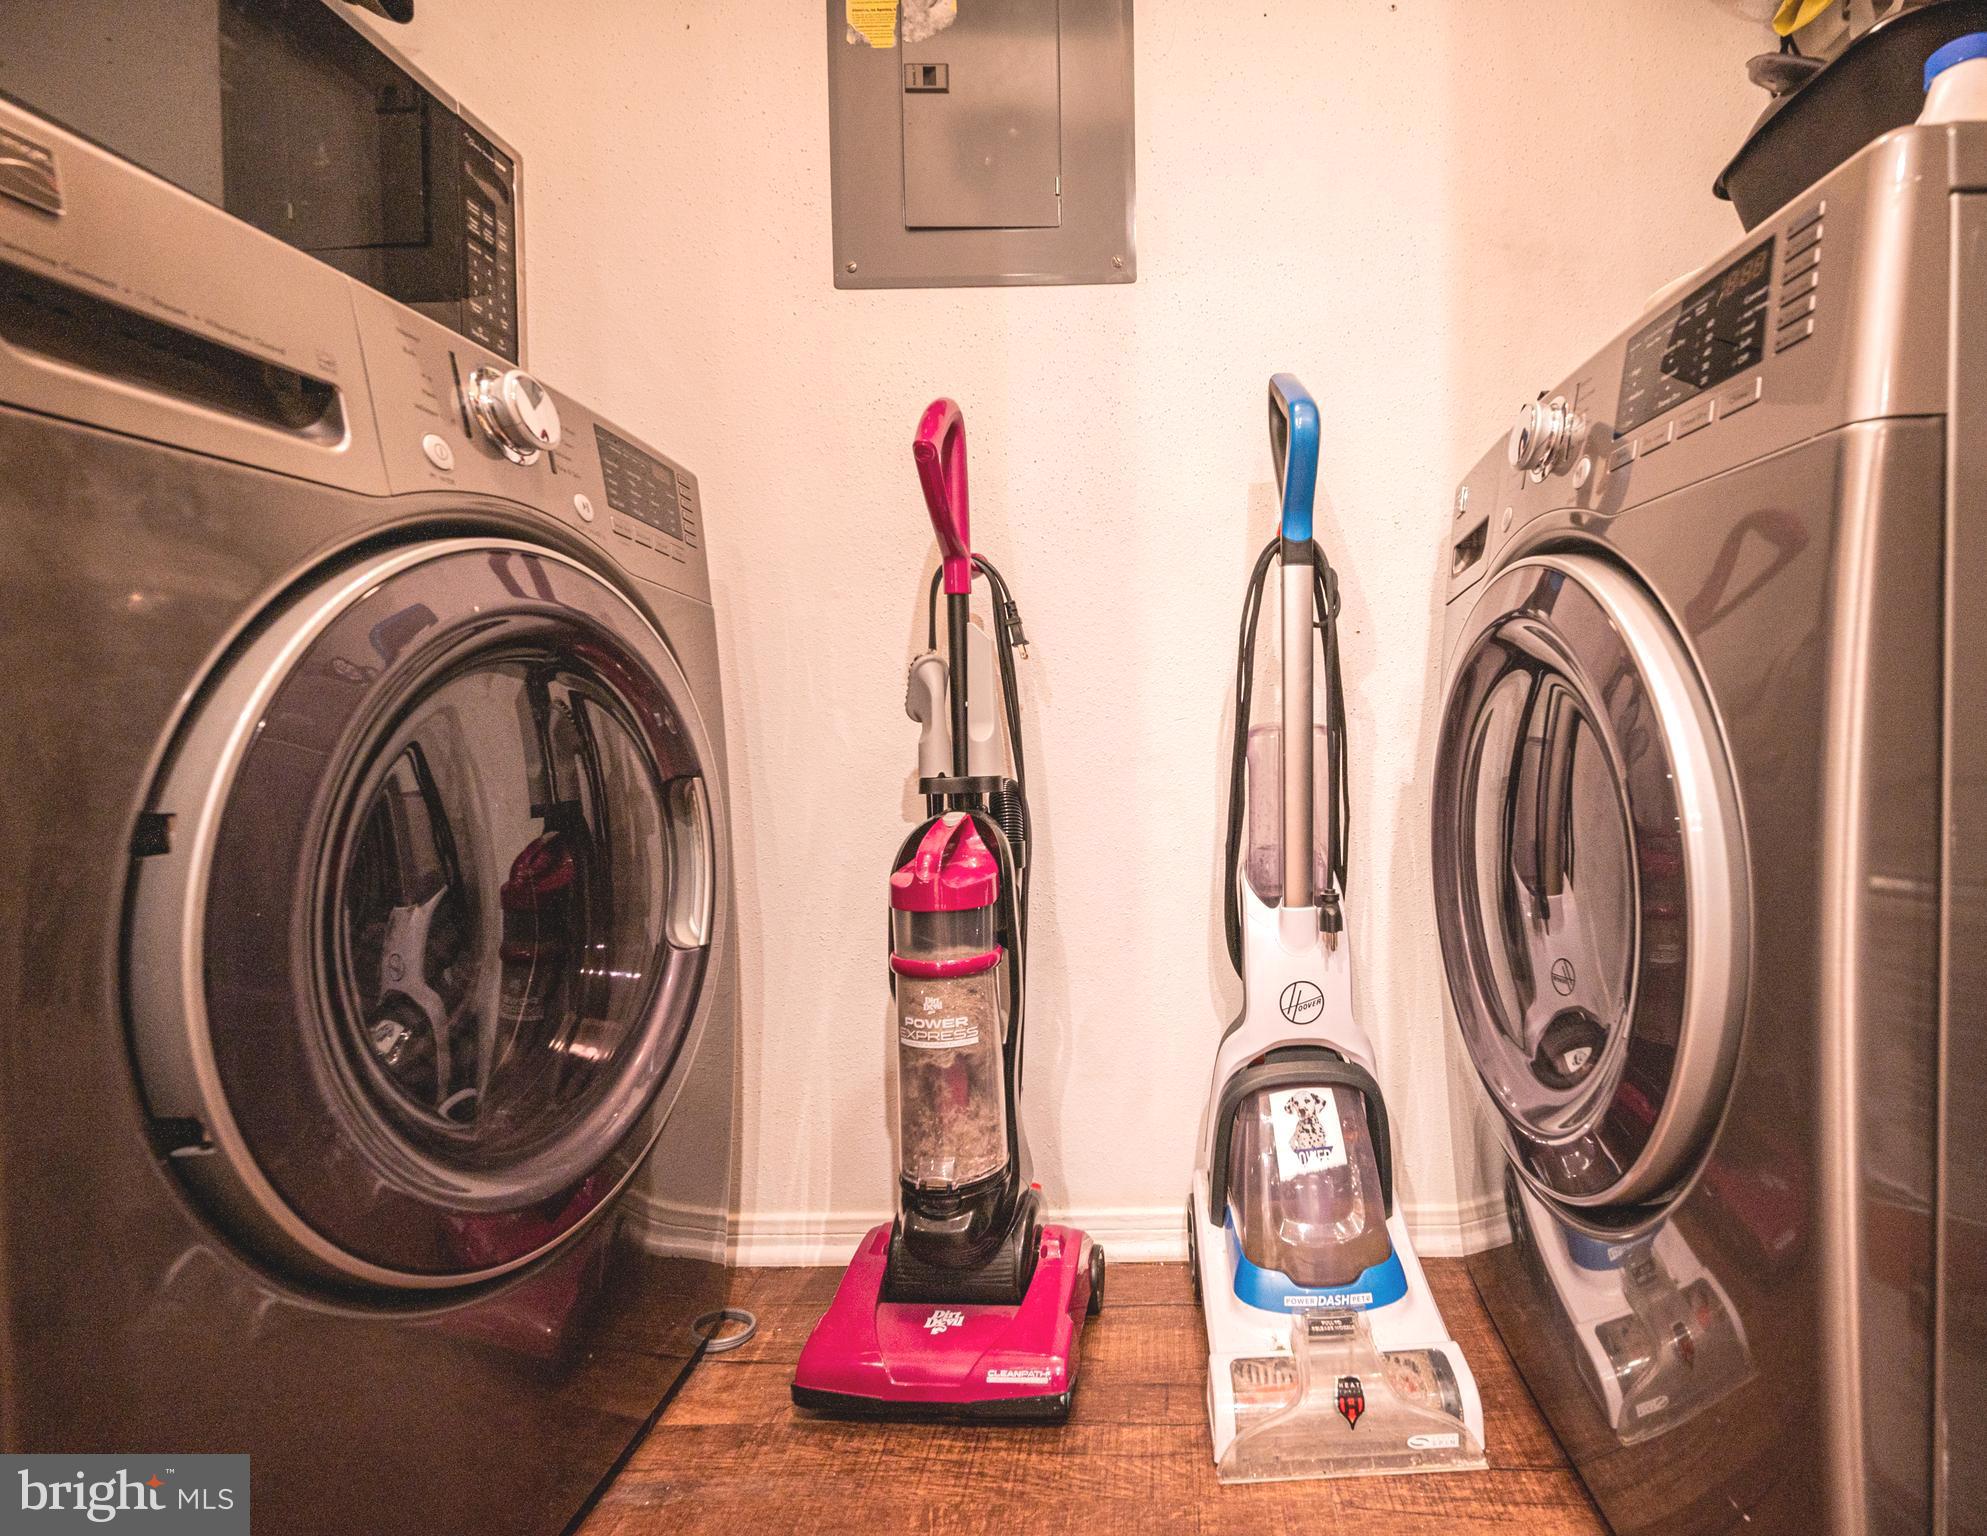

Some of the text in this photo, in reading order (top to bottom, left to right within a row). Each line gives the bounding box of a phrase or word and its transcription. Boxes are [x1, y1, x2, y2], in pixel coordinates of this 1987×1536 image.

[905, 1016, 969, 1029] POWER
[900, 1026, 979, 1041] EXPRESS
[1285, 1297, 1315, 1305] POWER
[1317, 1294, 1350, 1306] DASH
[930, 1310, 963, 1321] Dirt
[923, 1315, 965, 1335] Devil
[987, 1369, 1050, 1378] CLEANPATH
